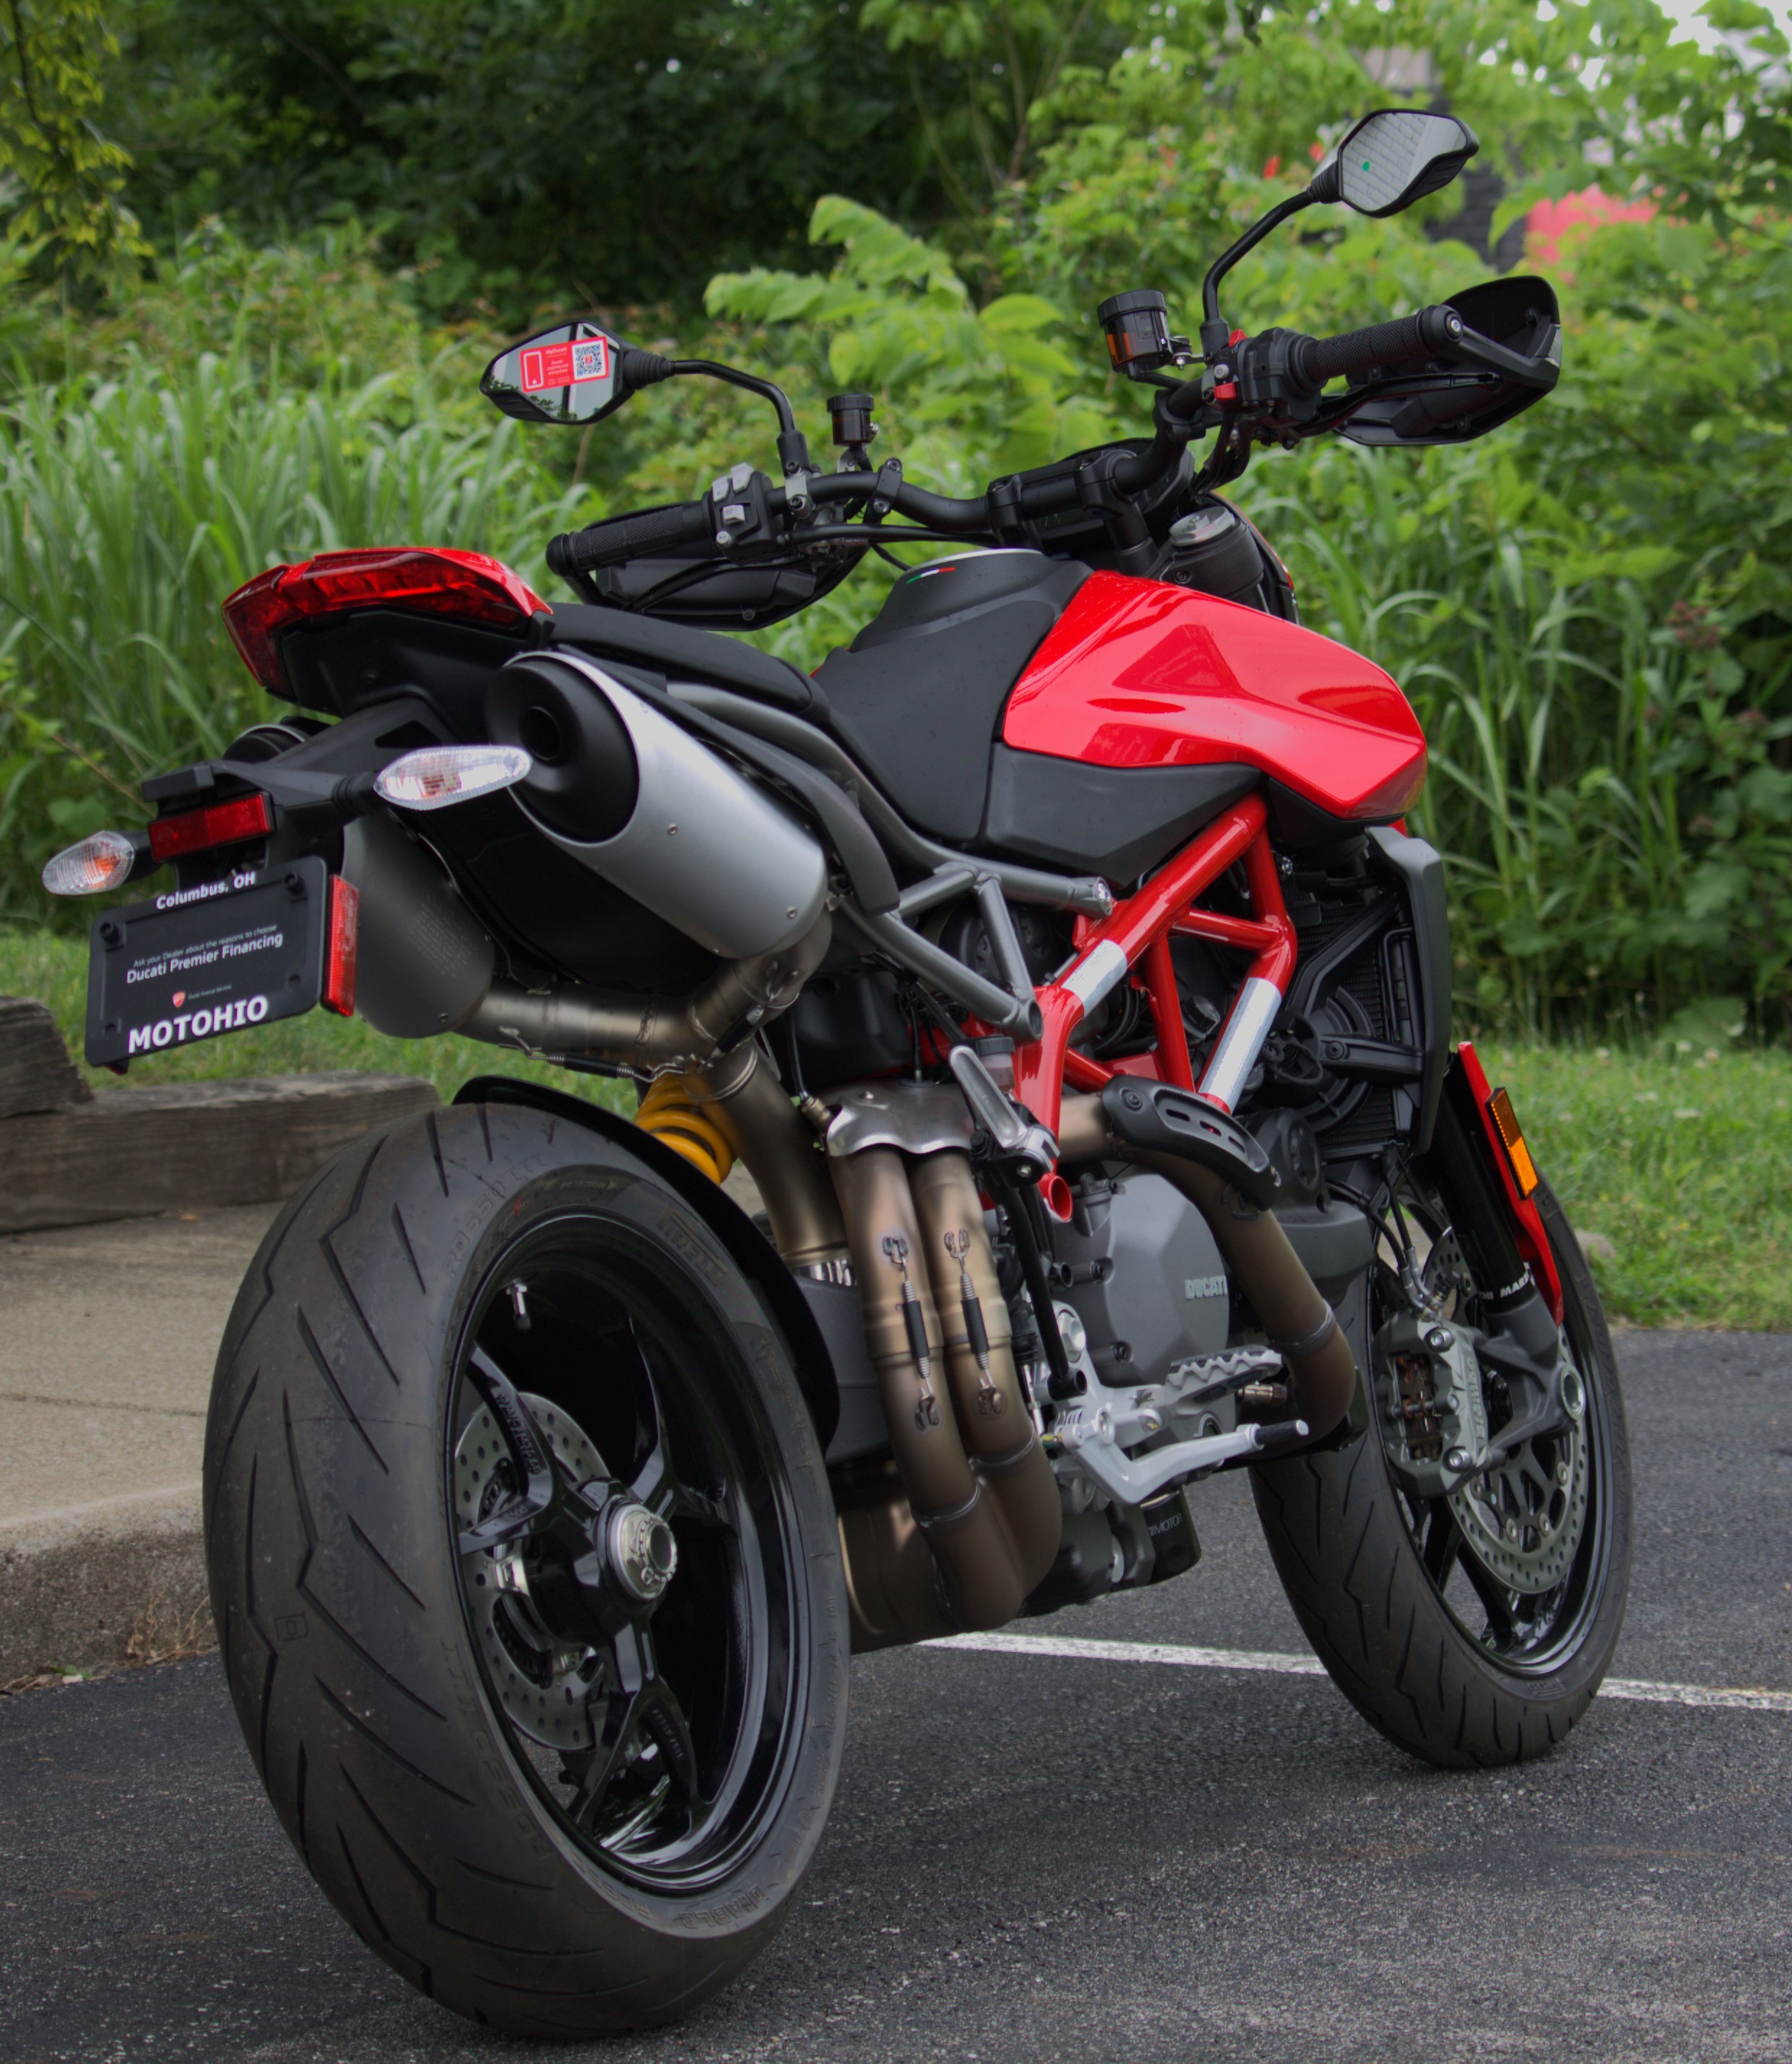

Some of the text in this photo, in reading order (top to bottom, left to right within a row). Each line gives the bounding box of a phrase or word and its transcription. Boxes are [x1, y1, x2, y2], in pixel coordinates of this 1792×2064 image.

[156, 872, 256, 910] Columbus, OH
[126, 932, 283, 984] Ducati Premier Financing
[134, 958, 145, 968] Ask
[147, 955, 161, 966] your
[163, 949, 184, 960] Dealer
[185, 943, 204, 955] about
[206, 940, 217, 949] the
[219, 934, 244, 945] reasons
[254, 924, 277, 937] choose
[129, 996, 268, 1054] MOTOHIO
[1184, 1275, 1228, 1300] DUCATI
